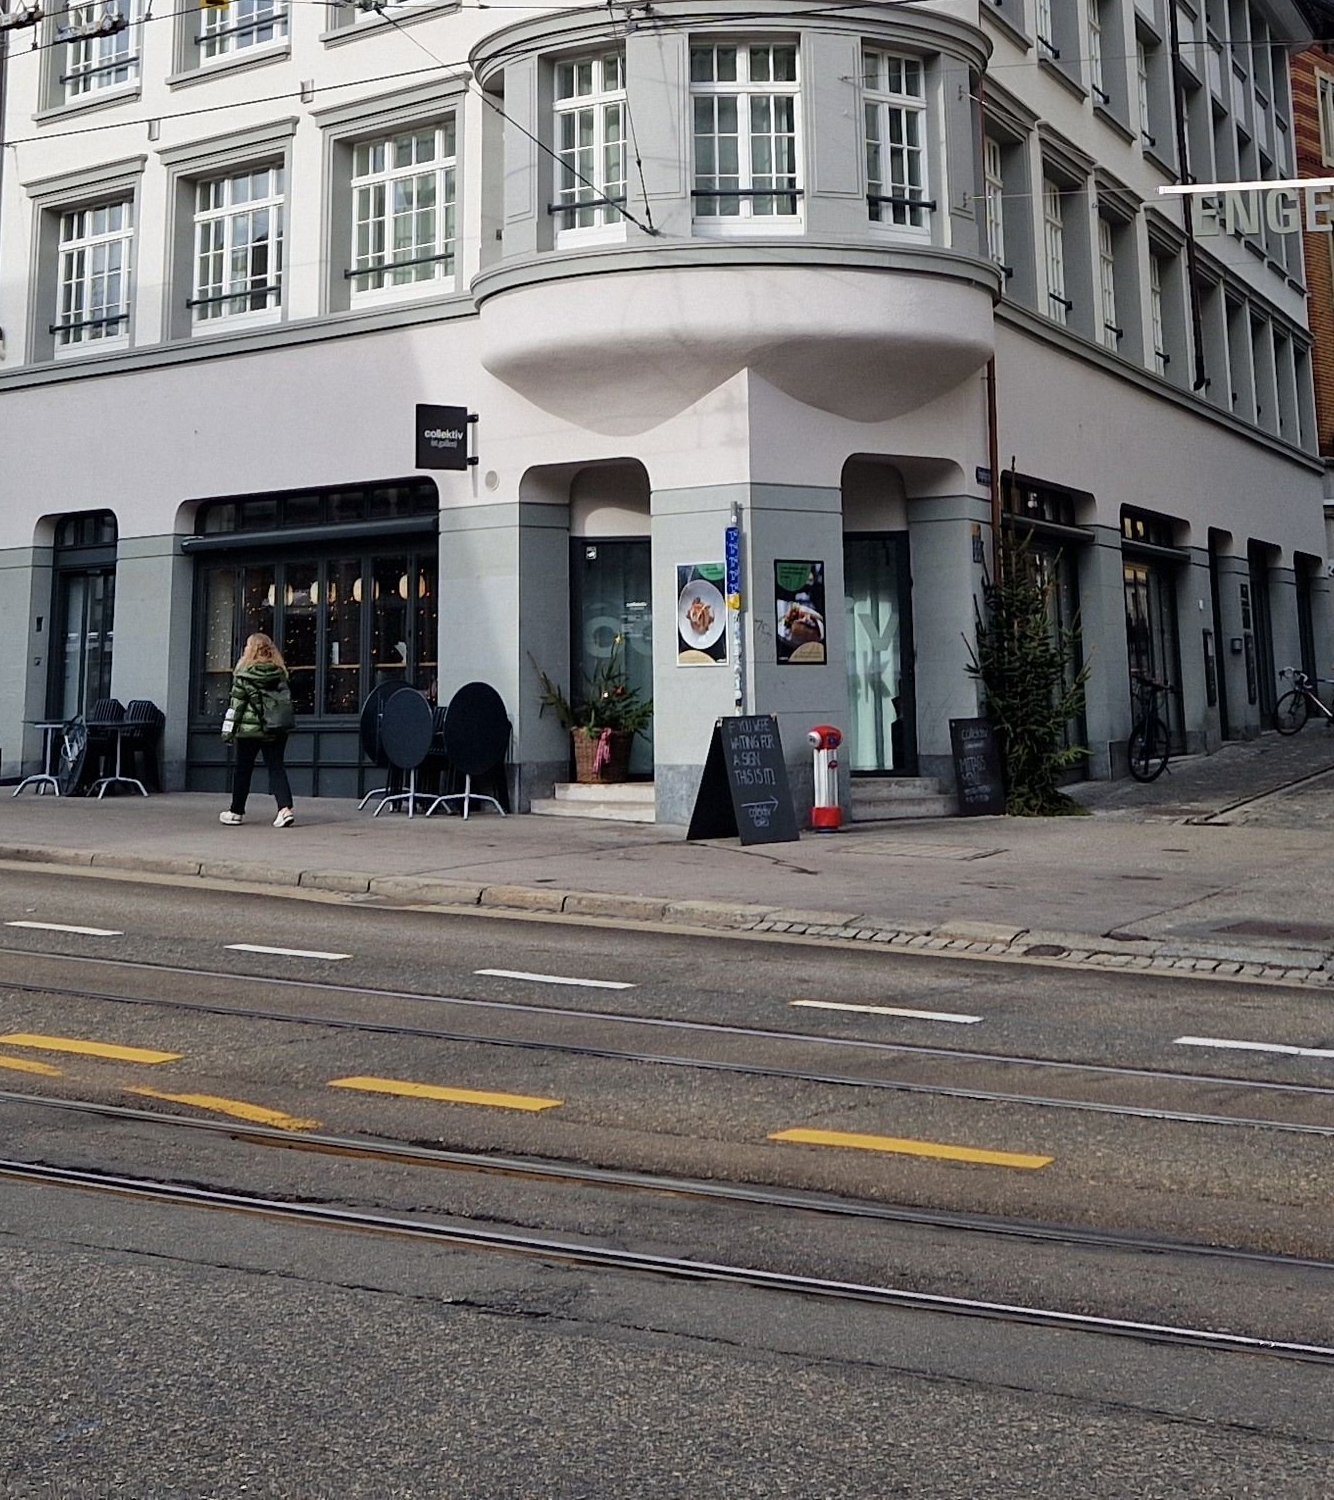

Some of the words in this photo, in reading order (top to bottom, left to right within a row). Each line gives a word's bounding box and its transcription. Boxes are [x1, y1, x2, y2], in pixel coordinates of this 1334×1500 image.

[424, 429, 464, 440] collektiv
[738, 721, 752, 733] YOU
[730, 735, 759, 750] WAITING
[760, 734, 775, 749] FOR
[733, 754, 741, 766] A
[742, 751, 761, 765] SIGN
[734, 769, 754, 785] THIS
[754, 769, 763, 784] IS
